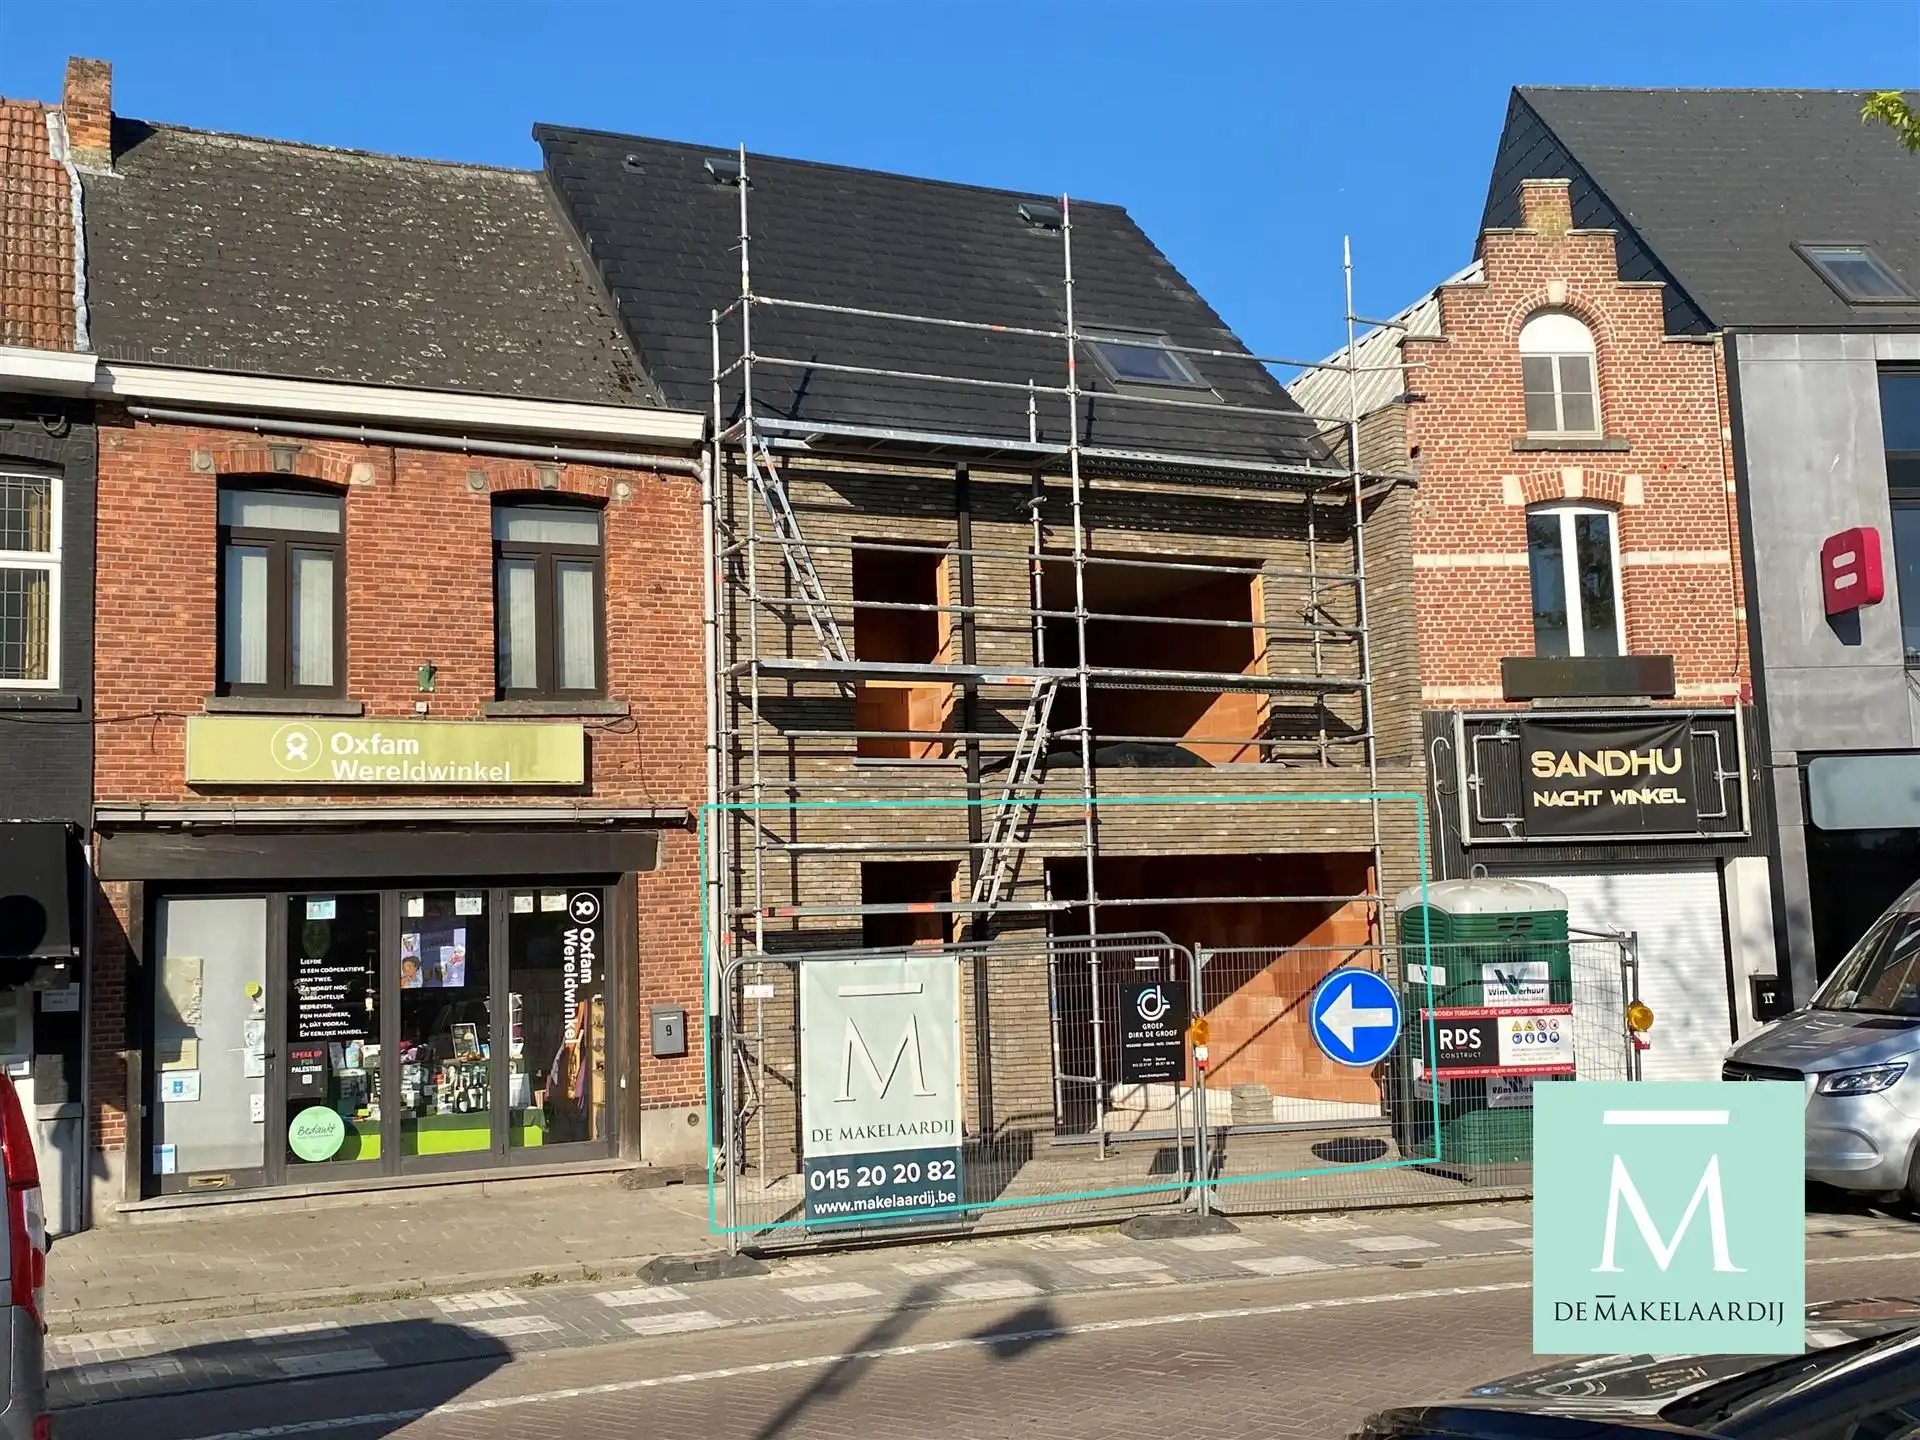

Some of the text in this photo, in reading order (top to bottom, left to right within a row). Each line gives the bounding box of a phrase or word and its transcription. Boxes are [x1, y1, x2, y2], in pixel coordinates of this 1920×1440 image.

[331, 731, 419, 755] Oxfam
[331, 759, 511, 782] Wereldwinkel
[1531, 747, 1682, 778] SANDHU
[1533, 787, 1686, 807] NACHT WINKEL
[579, 927, 595, 984] Oxfam
[563, 928, 580, 1044] Wereldwinkel
[1488, 988, 1507, 996] Wim
[666, 1024, 673, 1036] 9
[1128, 1031, 1144, 1039] DIRK
[1155, 1029, 1178, 1038] GROOF
[1141, 1022, 1164, 1031] GROEP
[1439, 1027, 1482, 1050] RDS
[291, 1050, 323, 1059] SPEAK UP
[1440, 1051, 1482, 1060] CONSTRUCT
[291, 1065, 323, 1073] PALESTINE
[812, 1119, 955, 1143] DE MAKELAARDIJ
[810, 1160, 956, 1191] 015 20 20 82
[814, 1189, 957, 1215] www.makelaardij.be
